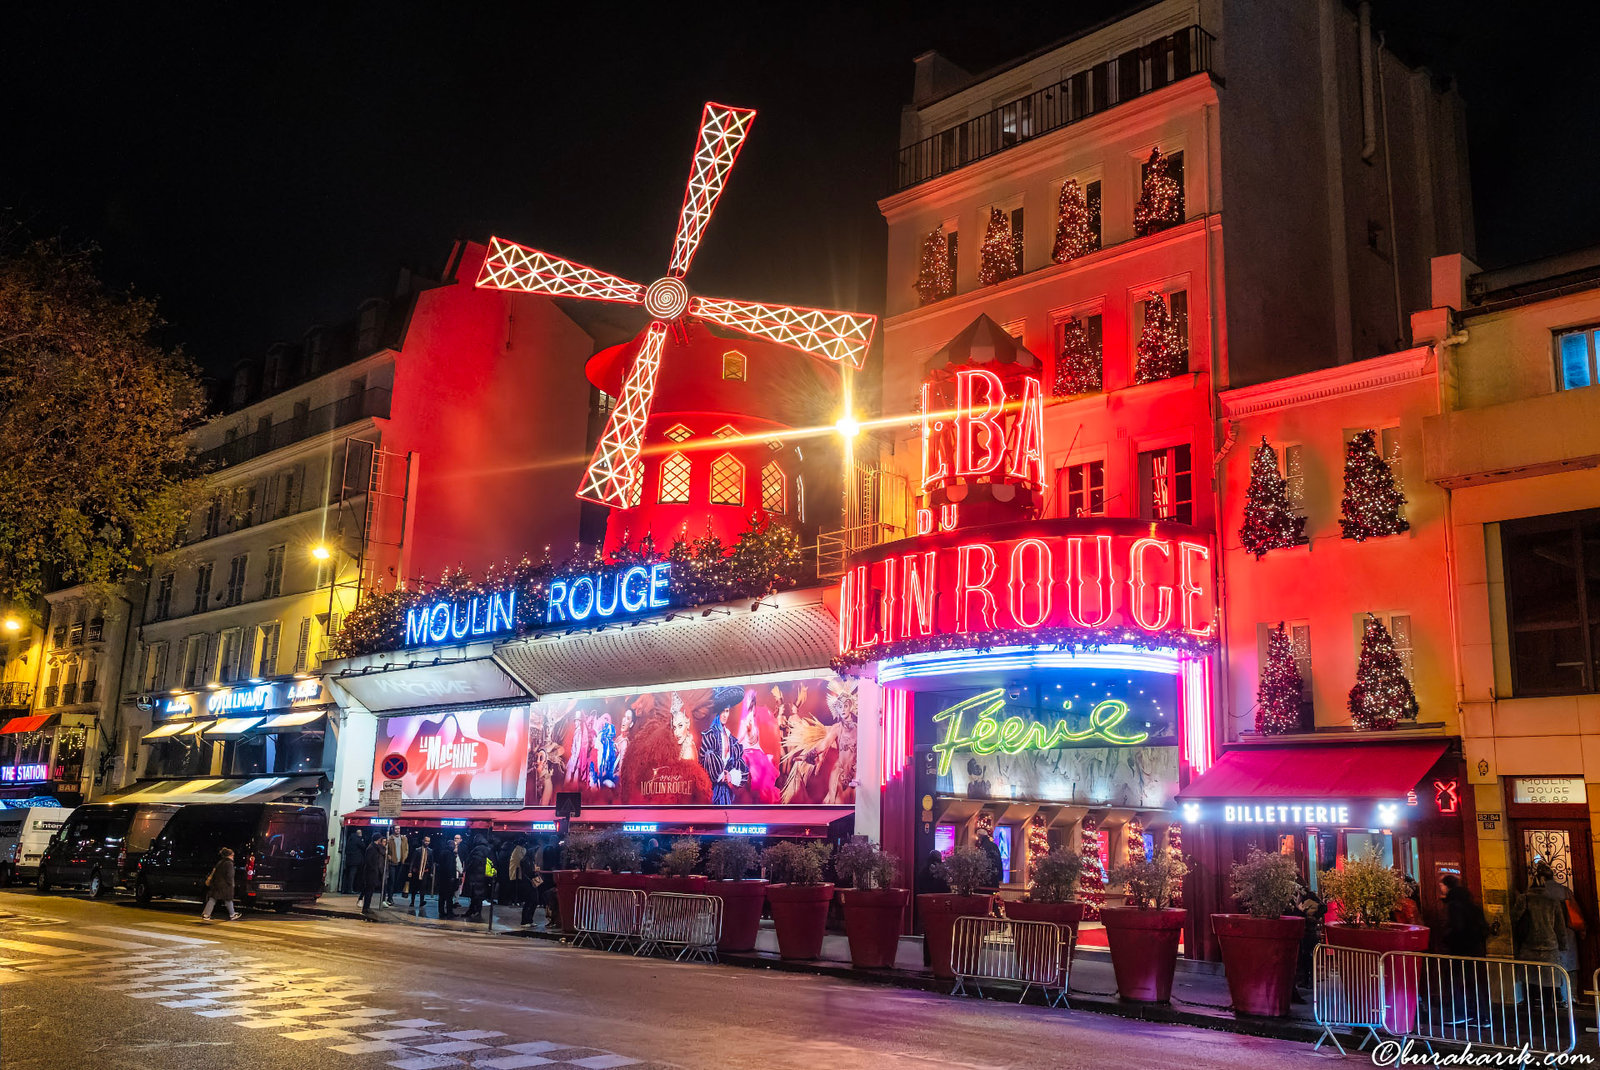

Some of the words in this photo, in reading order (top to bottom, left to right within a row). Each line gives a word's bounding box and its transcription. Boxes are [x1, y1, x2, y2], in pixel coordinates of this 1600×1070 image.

[917, 504, 957, 535] DU
[955, 536, 1211, 637] ROUGE
[405, 591, 515, 645] MOULIN
[546, 562, 672, 623] ROUGE
[932, 688, 1148, 776] Féerie
[1, 766, 16, 780] THE
[17, 765, 47, 780] STATION
[640, 780, 667, 795] MOULIN
[667, 779, 692, 795] ROUGE
[1224, 805, 1349, 823] BILLETTERIE
